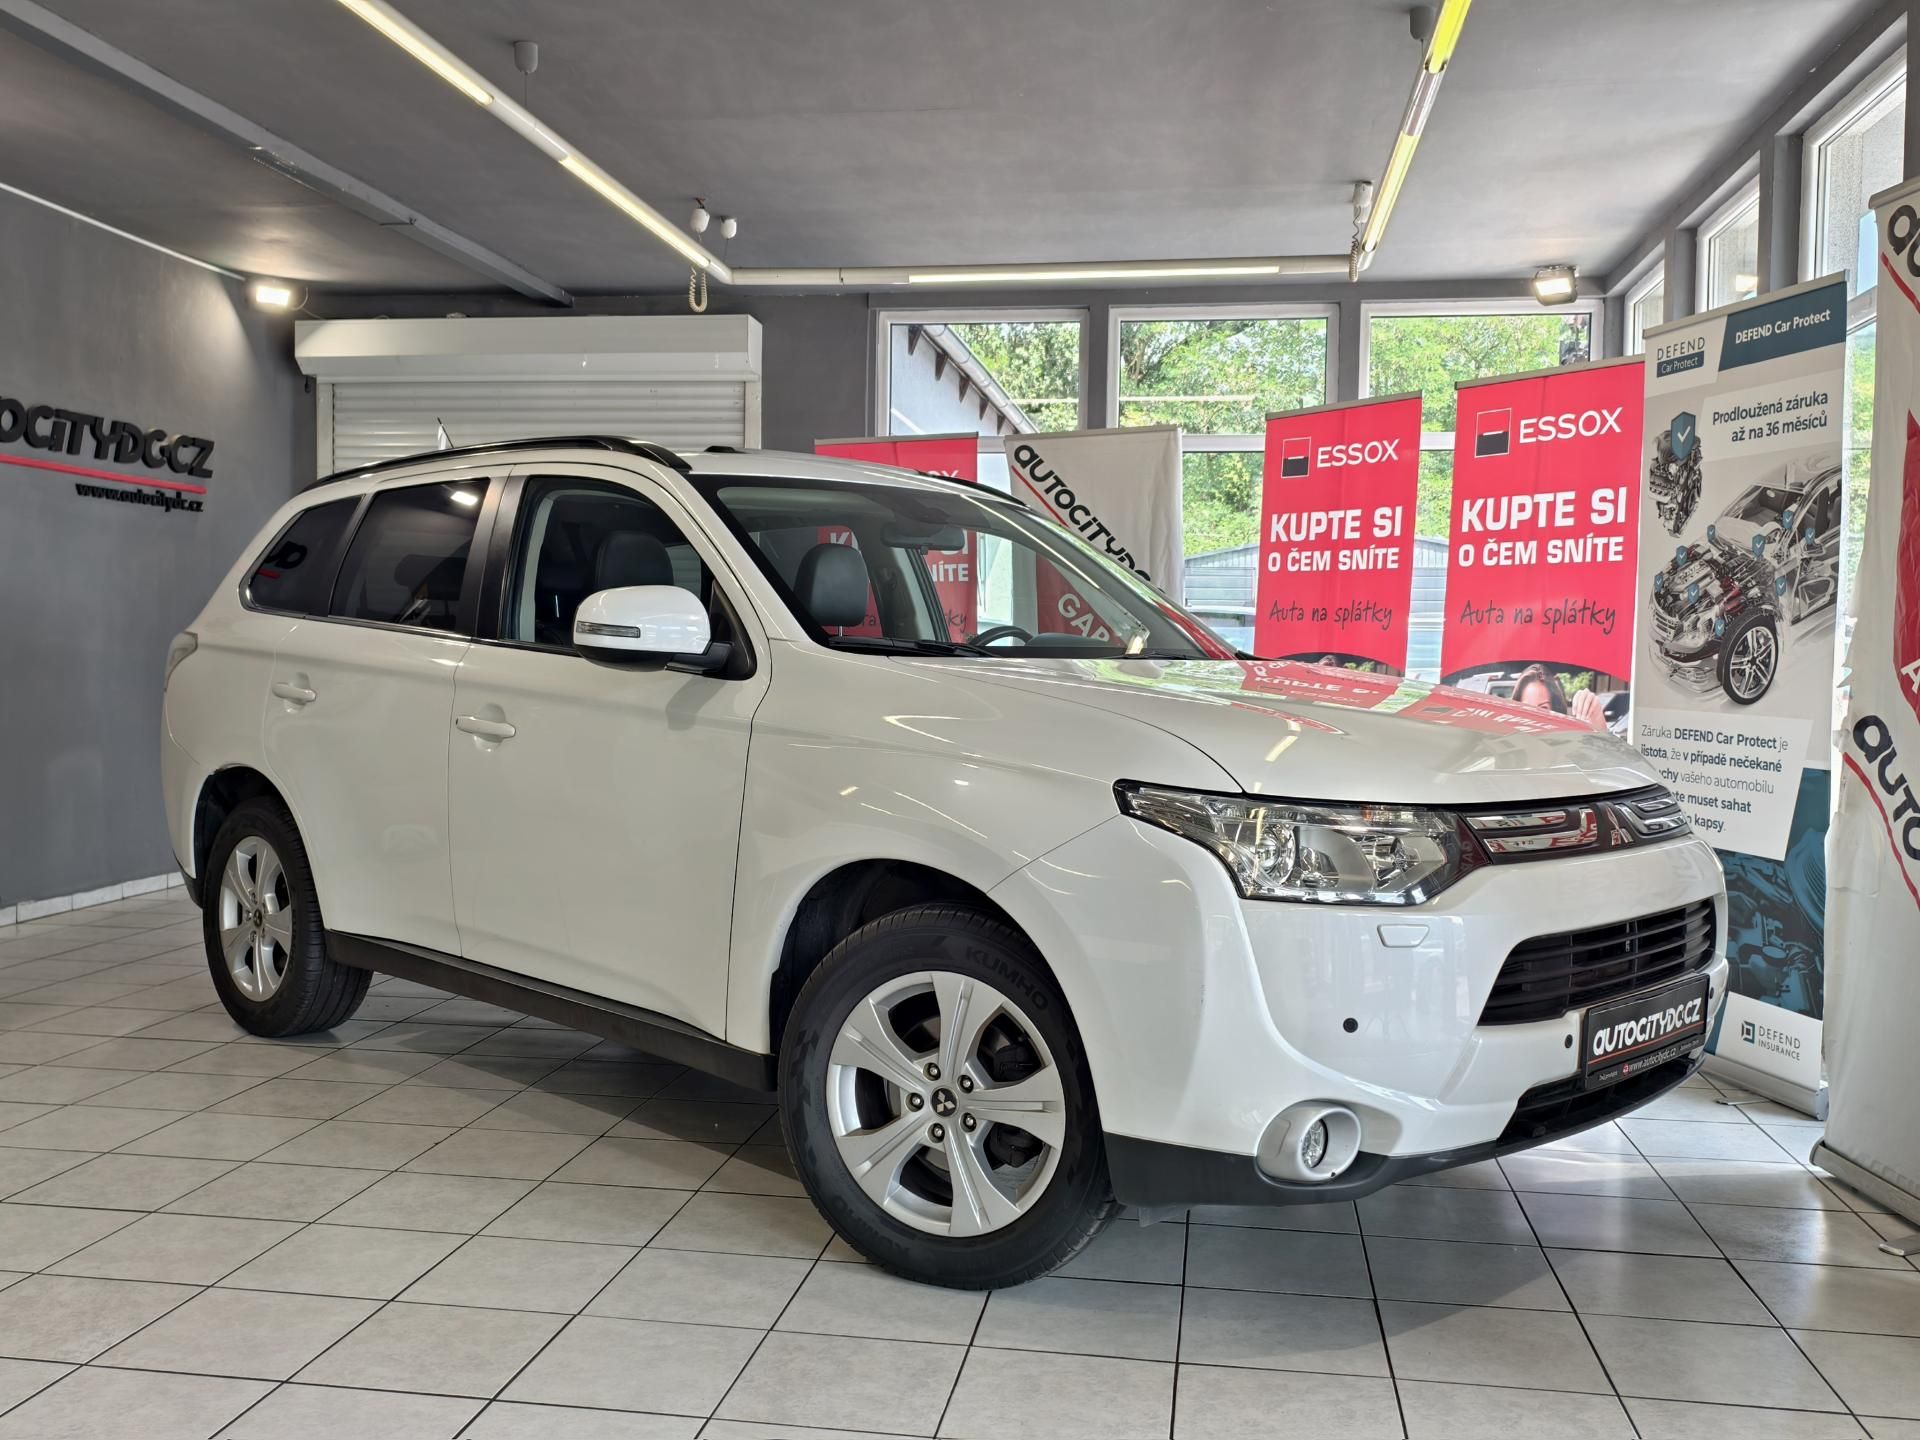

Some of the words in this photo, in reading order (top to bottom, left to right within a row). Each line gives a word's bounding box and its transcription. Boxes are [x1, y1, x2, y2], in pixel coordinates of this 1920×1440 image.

[1735, 324, 1772, 344] DEFEND
[1775, 320, 1791, 334] Car
[1793, 309, 1831, 329] Protect
[1657, 337, 1705, 360] DEFEND
[1661, 363, 1673, 374] Car
[1673, 357, 1698, 370] Protect
[1713, 397, 1783, 425] Prodloužená
[1786, 390, 1828, 411] záruka
[1519, 406, 1622, 445] ESSOX
[1731, 426, 1745, 442] až
[1748, 427, 1764, 440] na
[1766, 421, 1779, 437] 36
[1782, 410, 1827, 434] měsíců
[1317, 438, 1400, 468] ESSOX
[1270, 509, 1362, 542] KUPTE
[1373, 506, 1403, 538] SI
[1461, 491, 1576, 533] KUPTE
[1590, 487, 1628, 525] SI
[1268, 552, 1281, 572] O
[1287, 547, 1331, 572] ČEM
[1338, 544, 1400, 571] SNÍTE
[1458, 544, 1474, 567] O
[1483, 538, 1537, 566] ČEM
[1547, 532, 1624, 564] SNÍTE
[930, 560, 969, 582] NÍTE
[1270, 600, 1304, 622] Auta
[1312, 607, 1327, 622] na
[1334, 600, 1392, 631] splátky
[1460, 600, 1504, 625] Auta
[1514, 607, 1533, 625] na
[1541, 598, 1615, 635] splátky
[1641, 725, 1672, 739] Záruka
[1674, 728, 1713, 742] DEFEND
[1716, 732, 1734, 745] Car
[1737, 734, 1777, 749] Protect
[1778, 737, 1788, 752] je
[1671, 748, 1681, 761] že
[1683, 752, 1689, 760] v
[1691, 750, 1727, 766] případě
[1729, 756, 1782, 773] nečekané
[1659, 769, 1679, 783] chy
[1681, 771, 1712, 786] vašeho
[1714, 776, 1775, 794] automobilu
[1687, 794, 1718, 808] muset
[1721, 798, 1751, 813] sahat
[1694, 815, 1726, 832] kapsy.
[965, 946, 1048, 1011] KUMHO
[1759, 1026, 1800, 1049] DEFEND
[1759, 1040, 1800, 1061] INSURANCE
